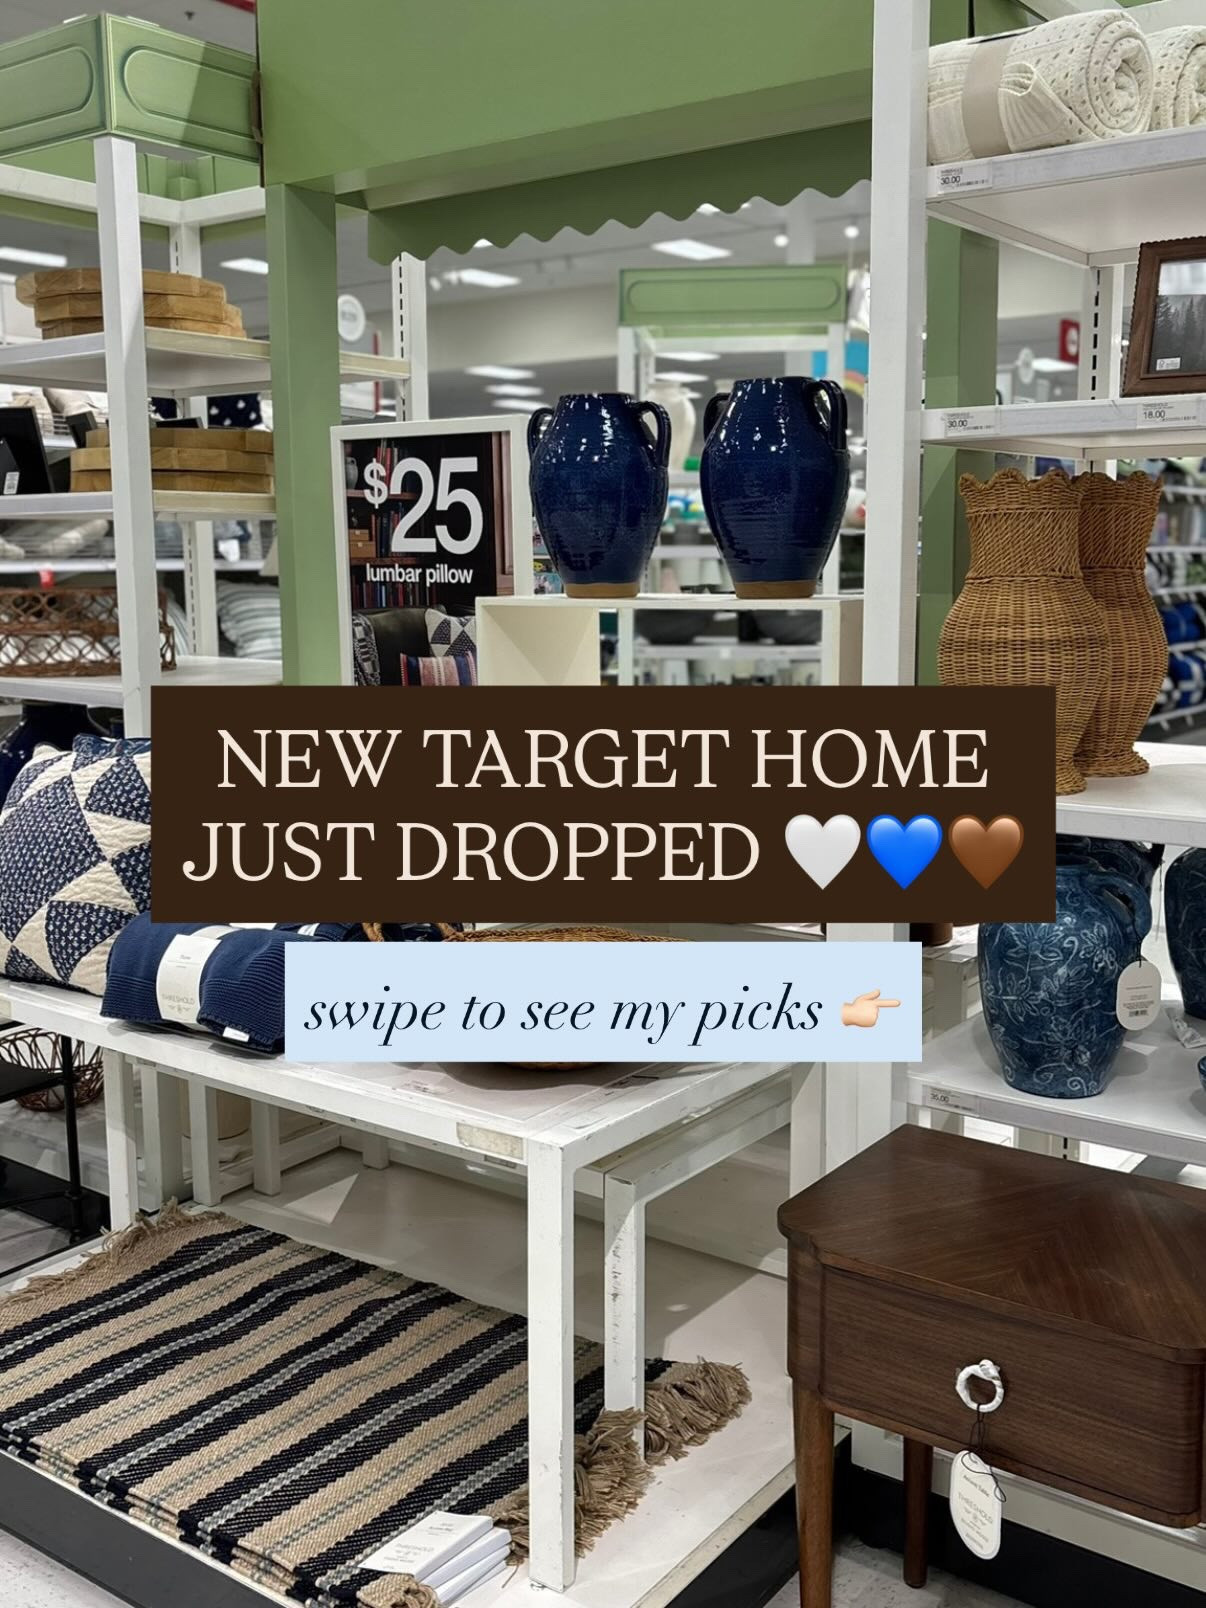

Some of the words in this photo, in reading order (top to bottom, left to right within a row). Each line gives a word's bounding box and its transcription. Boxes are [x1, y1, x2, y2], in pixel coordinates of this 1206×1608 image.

[940, 176, 961, 185] 30.00
[1143, 410, 1166, 419] 18.00
[947, 419, 968, 428] 30.00
[363, 457, 484, 555] $25
[366, 563, 423, 584] lumbar
[425, 563, 474, 587] pillow
